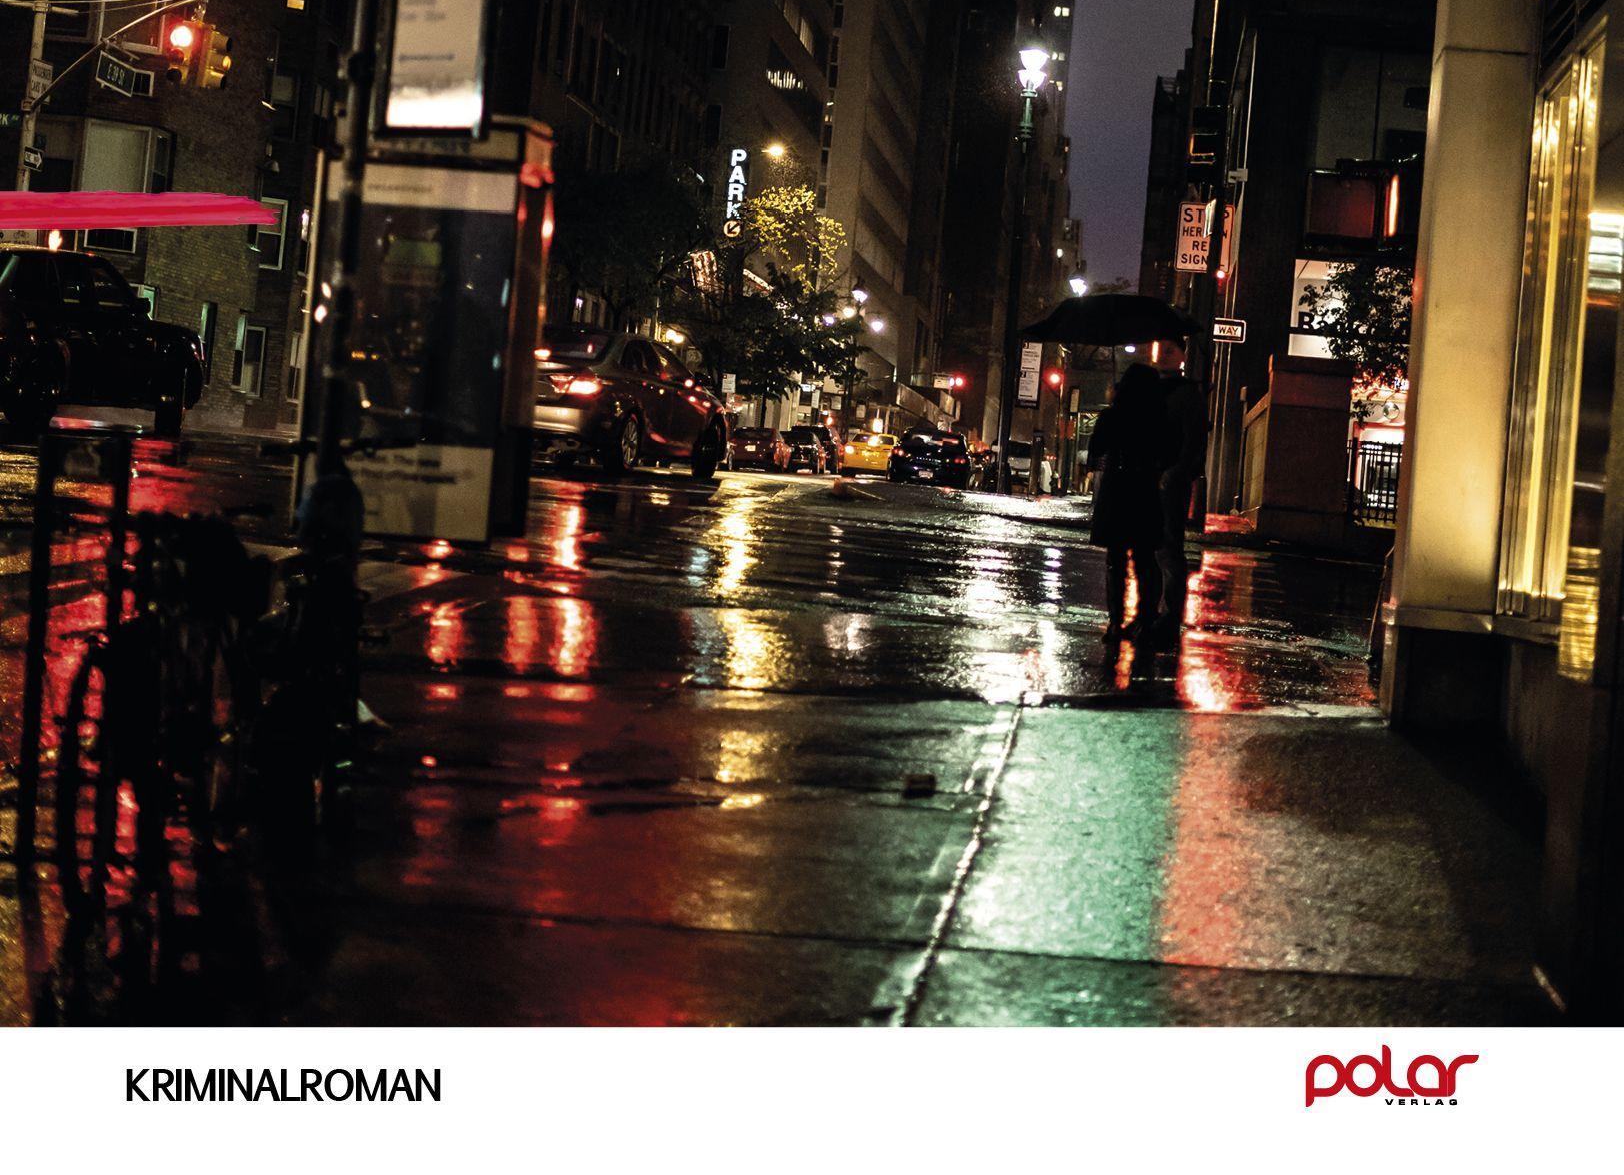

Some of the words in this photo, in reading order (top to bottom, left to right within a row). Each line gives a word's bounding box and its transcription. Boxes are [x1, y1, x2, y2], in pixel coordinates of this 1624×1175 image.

[726, 148, 747, 219] PARK
[1183, 207, 1230, 223] STP
[1182, 226, 1204, 238] HER
[1192, 240, 1208, 252] RE
[1181, 253, 1221, 266] SIGN
[1218, 326, 1239, 336] WAY
